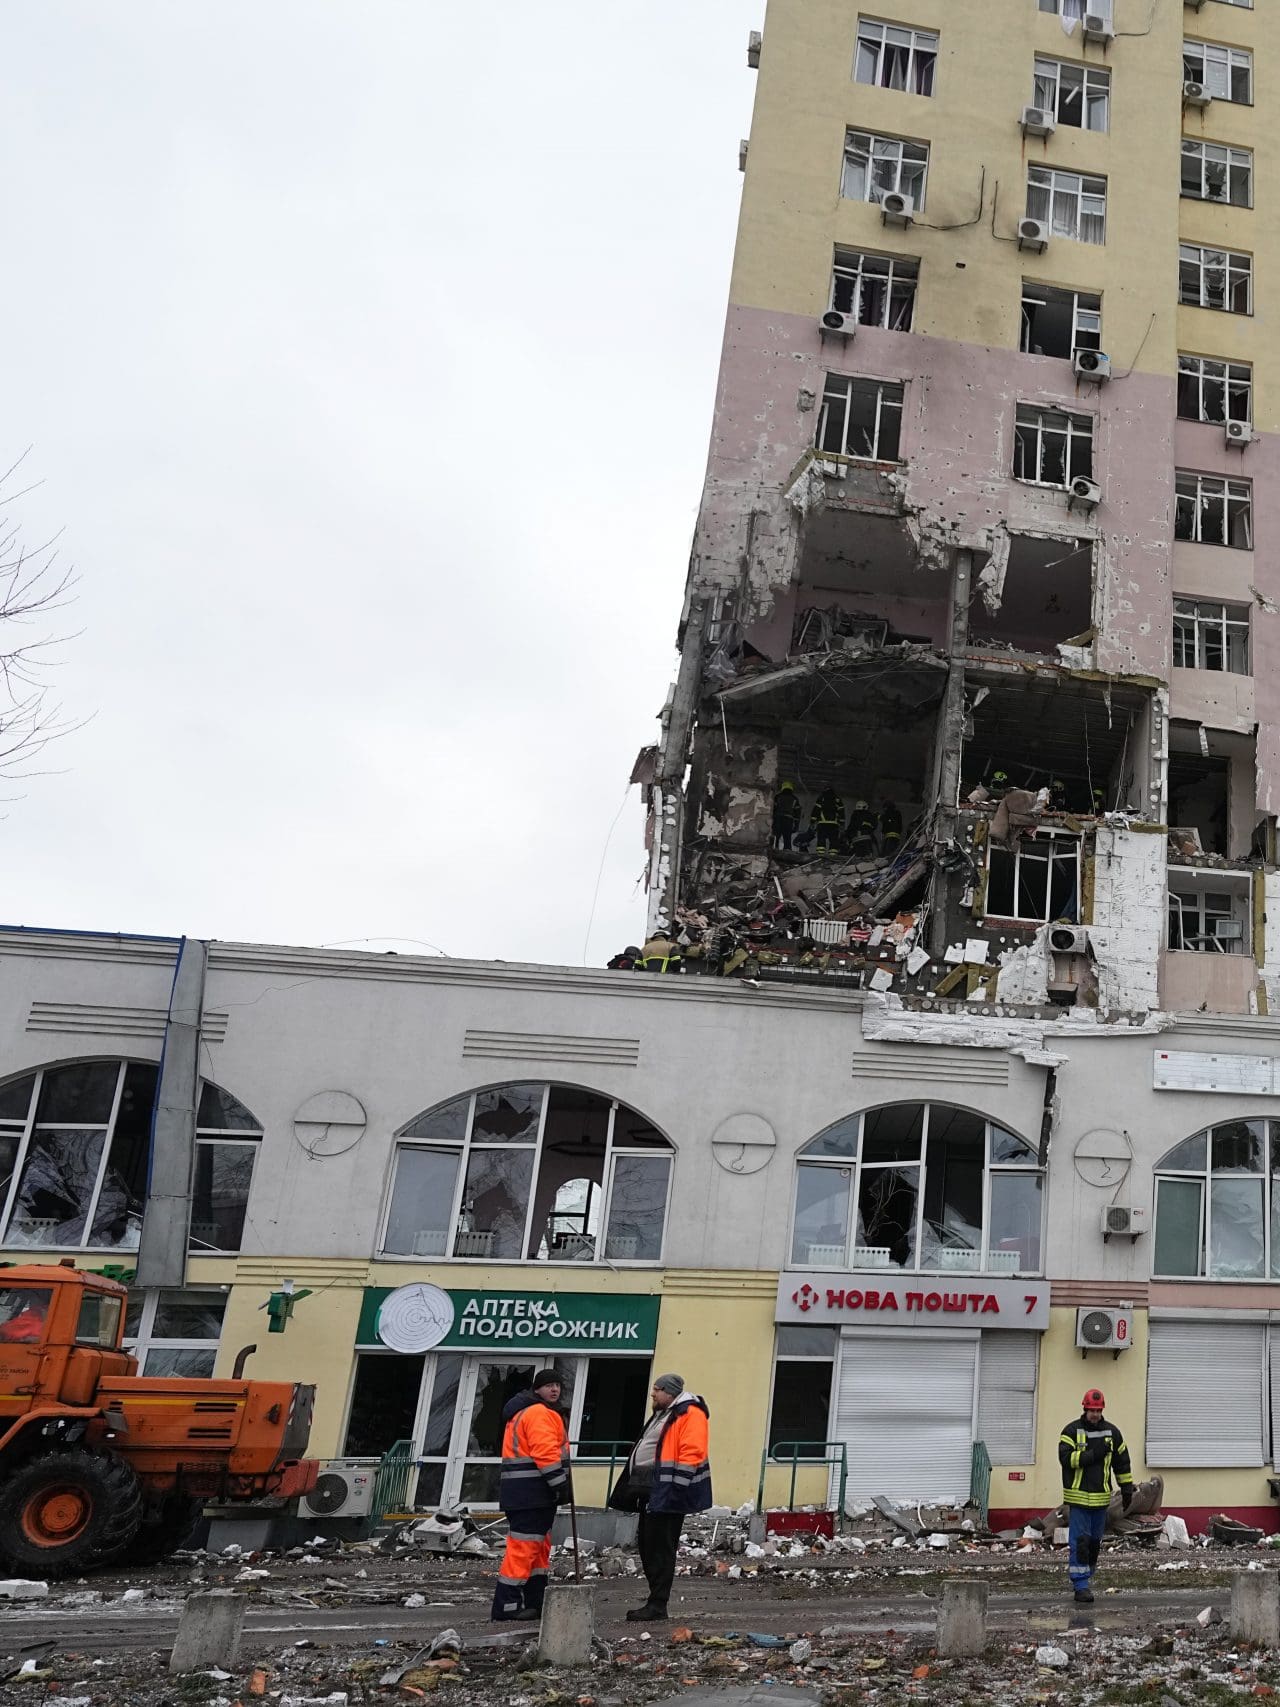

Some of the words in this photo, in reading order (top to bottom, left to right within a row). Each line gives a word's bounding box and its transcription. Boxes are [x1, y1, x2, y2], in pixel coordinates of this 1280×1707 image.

[462, 1299, 559, 1319] АПТЕКА
[826, 1289, 898, 1310] НОВА
[905, 1291, 1000, 1313] ПОШТА
[1024, 1296, 1037, 1313] 7
[459, 1318, 639, 1339] ПОДОРОЖНИК
